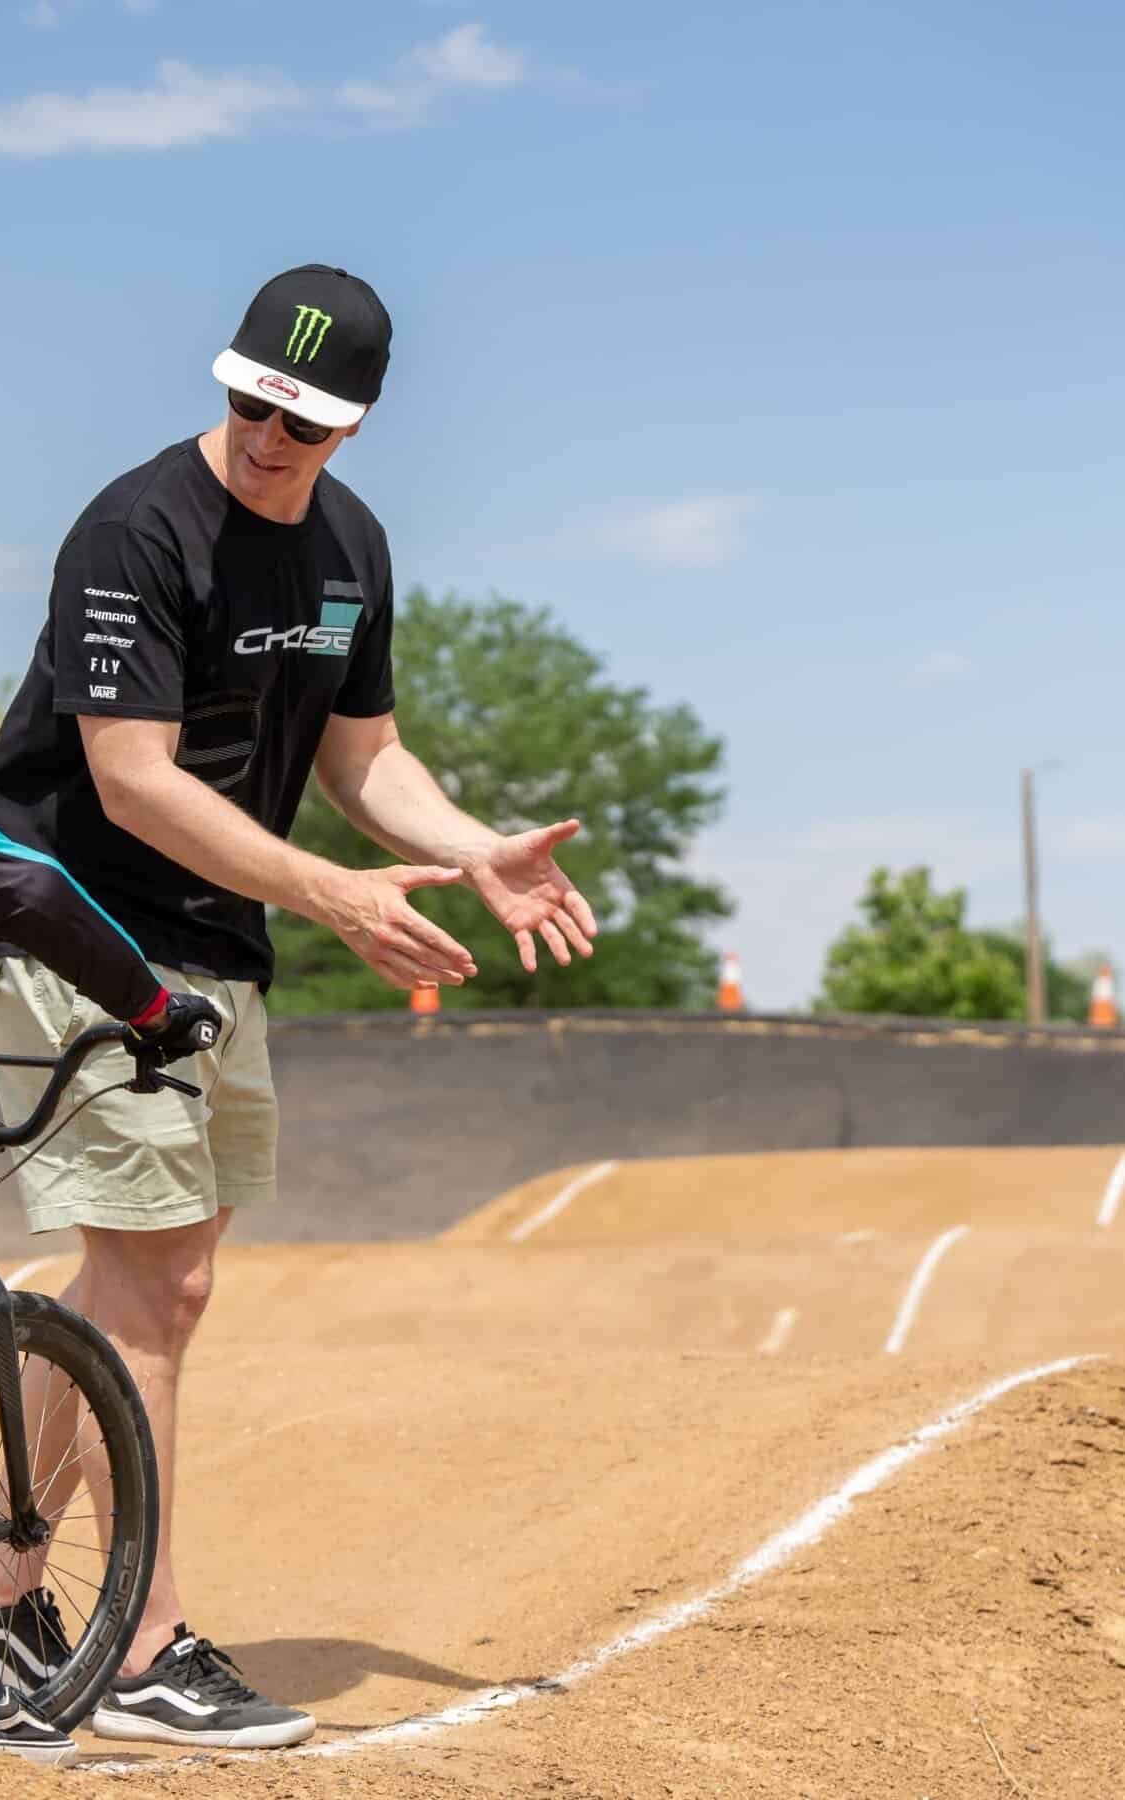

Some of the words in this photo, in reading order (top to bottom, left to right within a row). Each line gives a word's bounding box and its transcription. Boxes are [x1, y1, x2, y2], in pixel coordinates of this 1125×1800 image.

[85, 608, 136, 625] SHIMANO
[233, 624, 352, 655] CHASE
[90, 657, 120, 675] FLY
[89, 684, 117, 700] VANS
